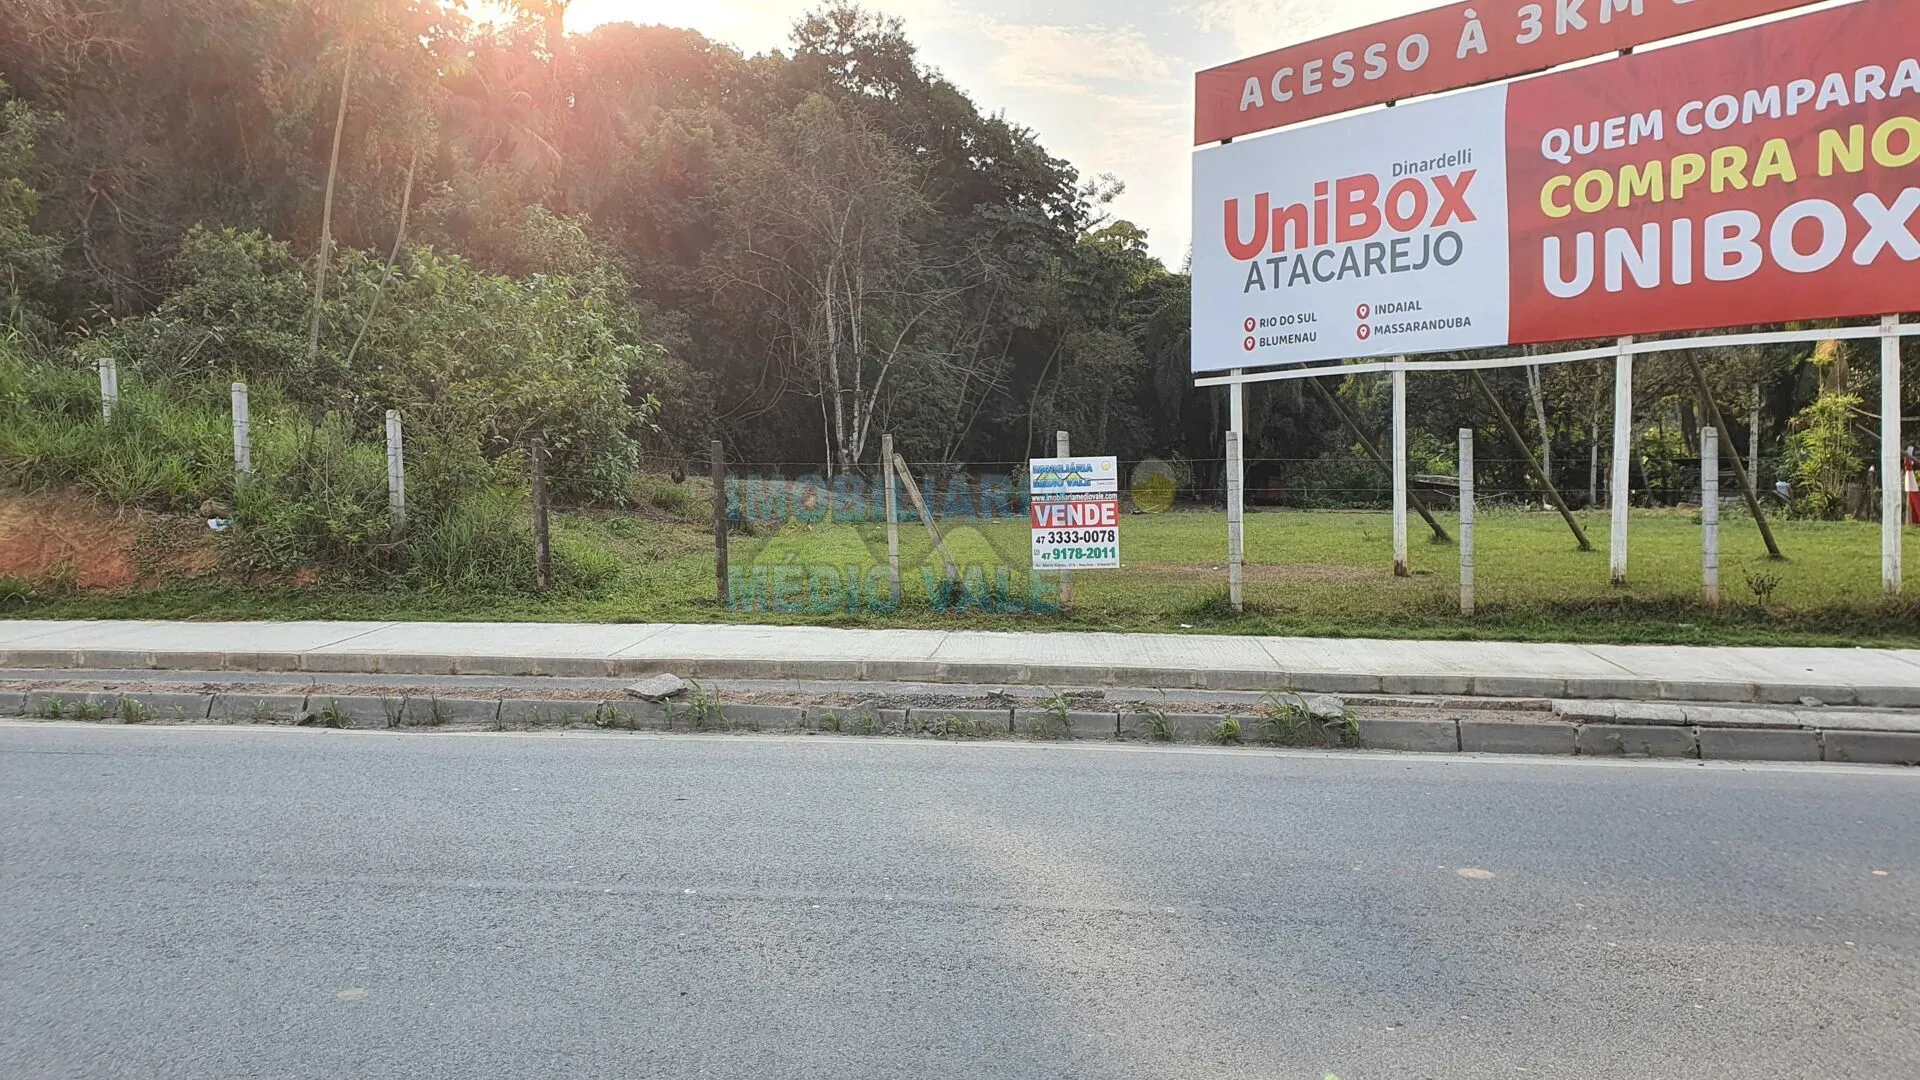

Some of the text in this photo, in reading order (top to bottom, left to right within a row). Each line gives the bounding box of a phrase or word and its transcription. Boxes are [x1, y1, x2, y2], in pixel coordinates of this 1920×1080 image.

[1239, 33, 1430, 112] ACESSO
[1456, 8, 1488, 59] À
[1541, 58, 1920, 164] QUEM COMPARA
[1392, 148, 1472, 177] Dinardelli
[1540, 116, 1920, 218] COMPRA NO
[1543, 187, 1920, 298] UNIBOX
[1244, 231, 1464, 294] ATACAREJO
[1374, 300, 1423, 315] INDAIAL
[1259, 312, 1318, 328] RIO DO SUL
[1374, 317, 1472, 335] MASSARANDUBA
[1259, 331, 1318, 347] BLUMENAU
[1067, 479, 1091, 487] VALE
[1034, 503, 1116, 527] VENDE
[1036, 529, 1116, 545] 47 3333-0078
[1041, 546, 1116, 560] 47 9178-2011
